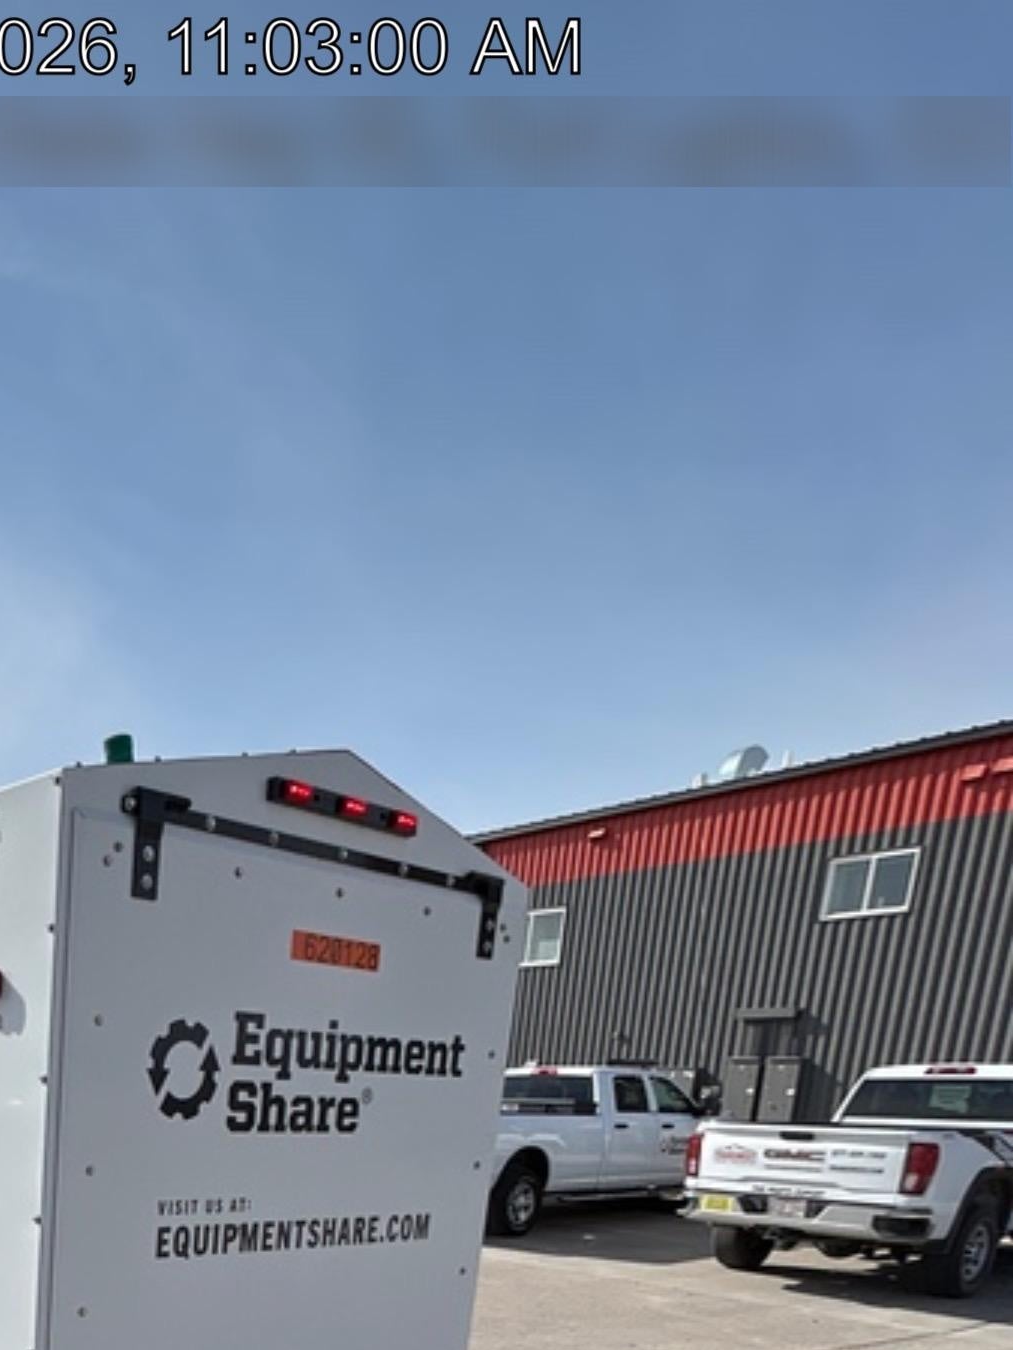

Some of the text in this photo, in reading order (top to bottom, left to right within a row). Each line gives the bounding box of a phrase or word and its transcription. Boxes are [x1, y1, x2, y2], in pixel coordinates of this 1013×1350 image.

[304, 932, 380, 971] 620128
[232, 1010, 465, 1083] Equipment
[226, 1080, 361, 1134] Share
[157, 1197, 253, 1217] VISIT US AT:
[155, 1213, 432, 1260] EQUIPMENTSHARE.COM
